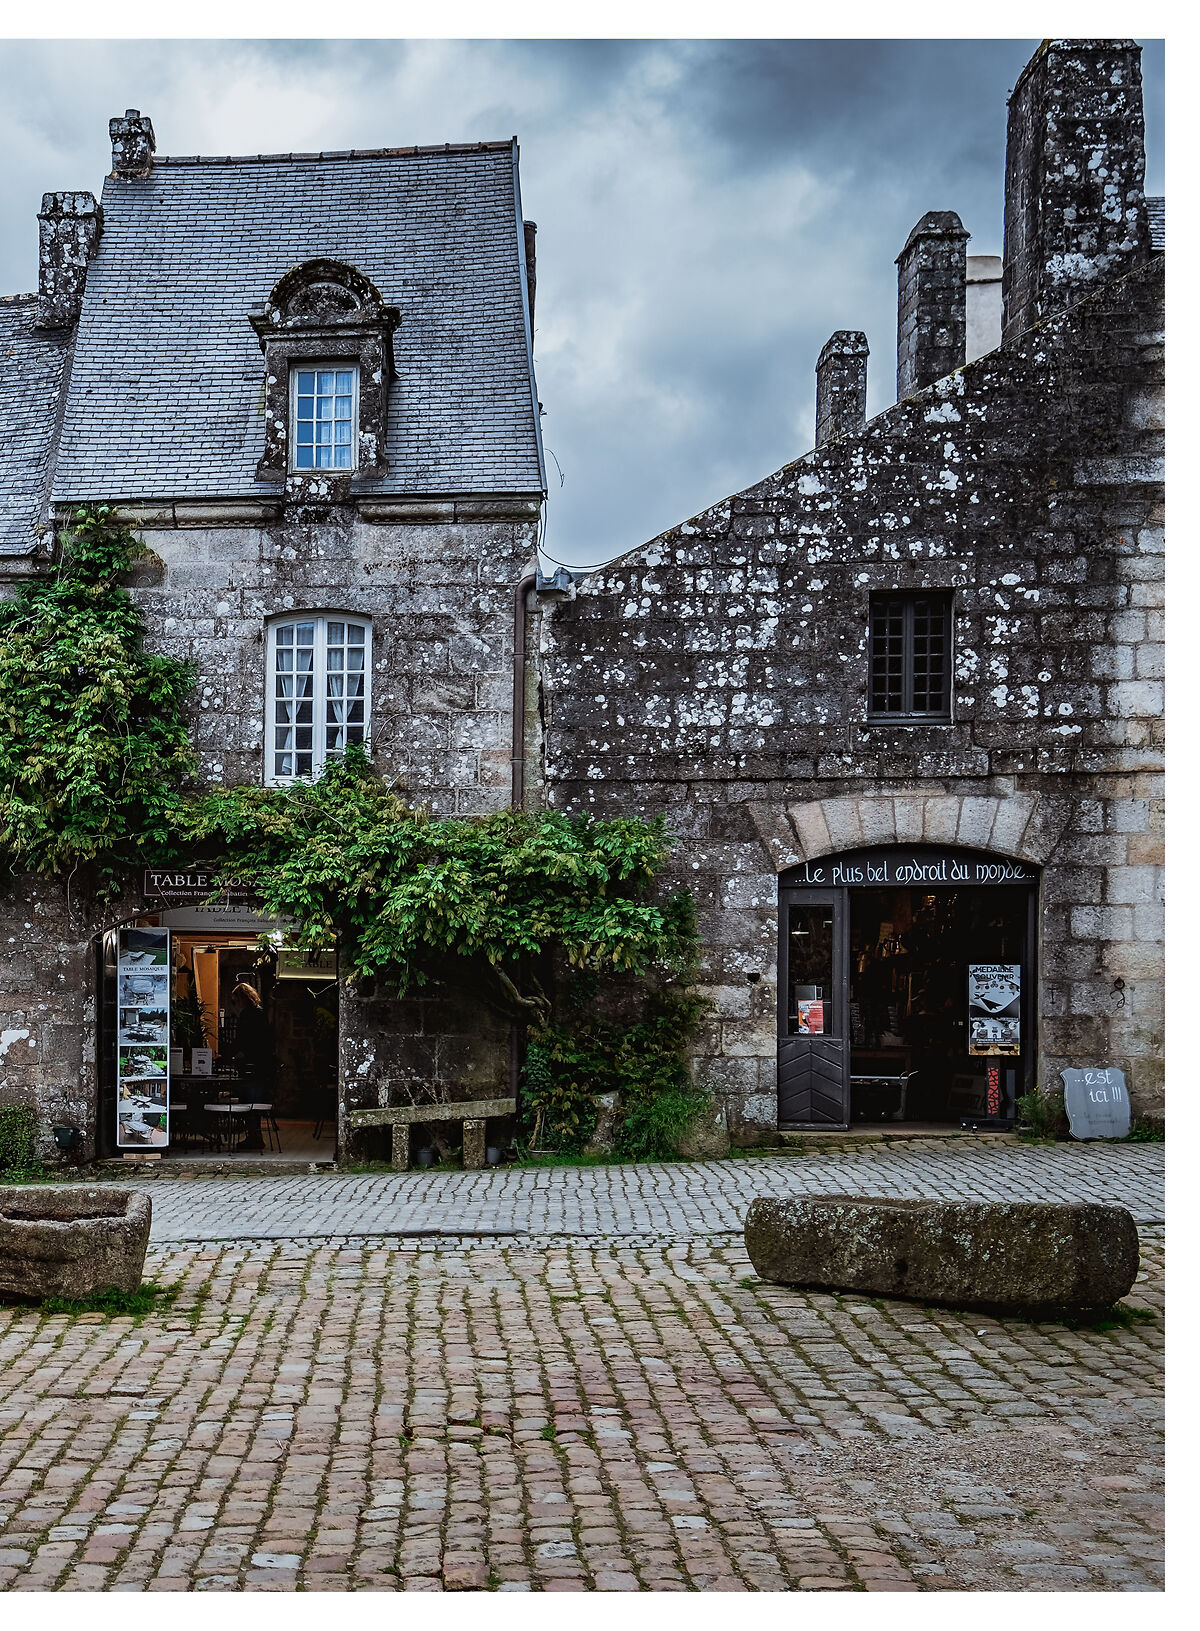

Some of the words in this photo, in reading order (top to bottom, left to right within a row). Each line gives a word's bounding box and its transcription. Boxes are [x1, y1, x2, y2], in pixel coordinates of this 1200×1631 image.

[832, 861, 864, 885] plus
[866, 860, 890, 883] bel
[895, 858, 948, 884] endroit
[950, 859, 971, 881] du
[150, 874, 208, 887] TABLE
[1088, 1088, 1110, 1103] ici
